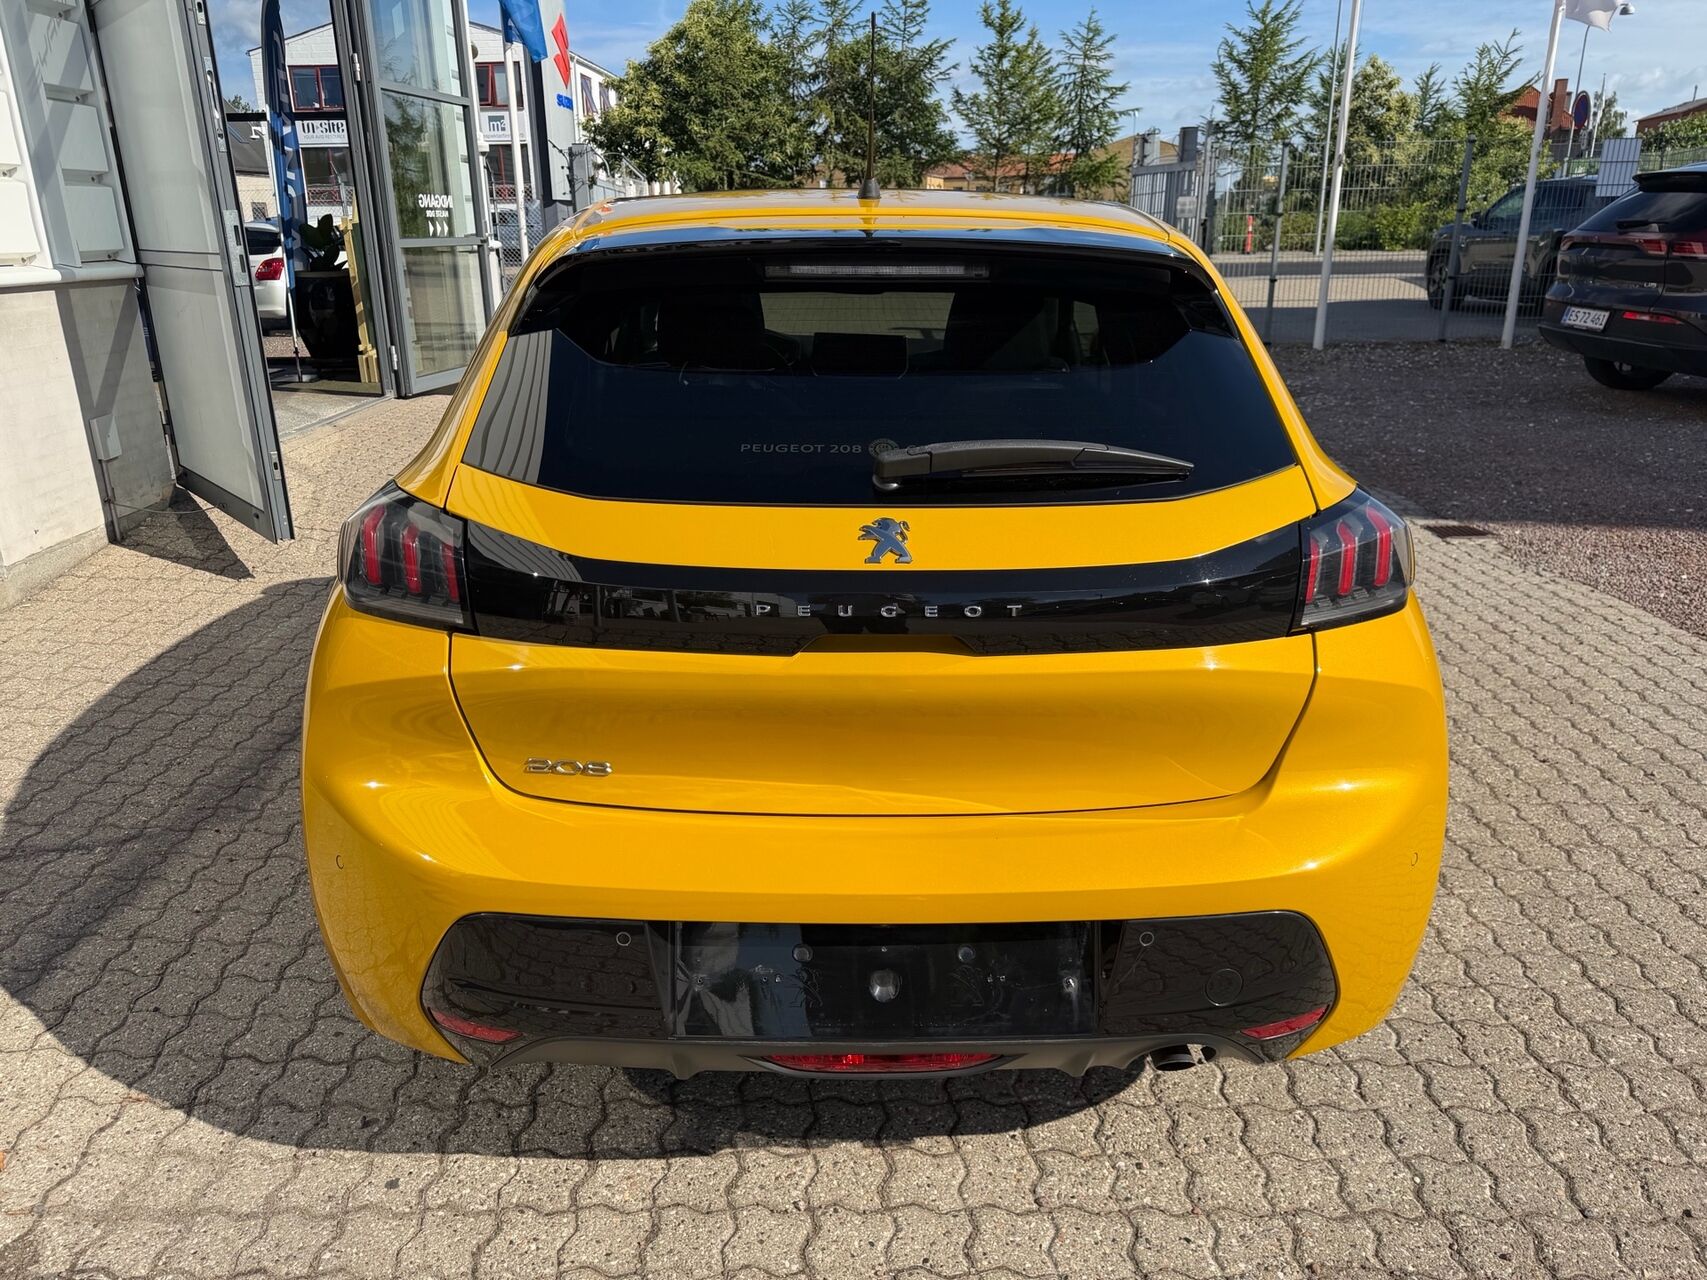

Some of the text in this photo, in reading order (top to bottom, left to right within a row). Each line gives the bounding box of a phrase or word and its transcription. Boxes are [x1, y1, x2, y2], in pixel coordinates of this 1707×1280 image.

[740, 444, 825, 453] PEUGEOT
[829, 444, 862, 454] 208
[756, 604, 1023, 617] PEUGEOT
[525, 757, 613, 777] 208
